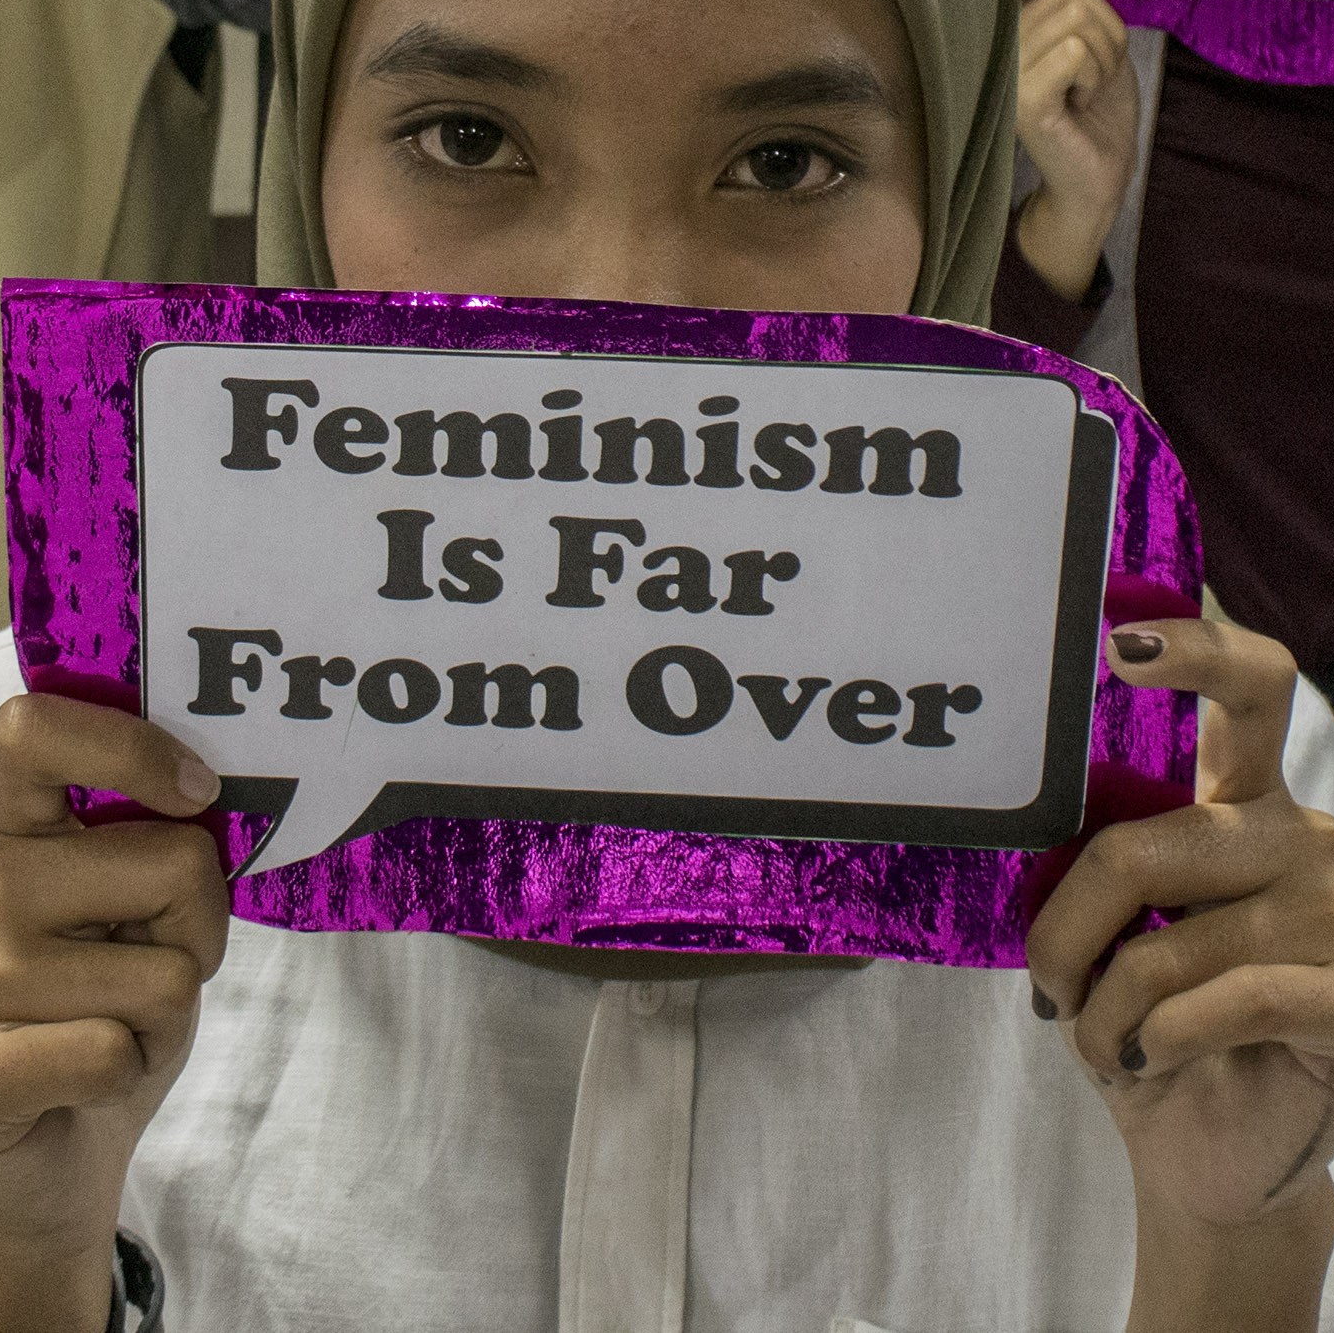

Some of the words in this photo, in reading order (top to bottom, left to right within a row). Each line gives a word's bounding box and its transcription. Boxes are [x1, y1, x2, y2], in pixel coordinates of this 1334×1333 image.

[219, 377, 963, 498] Feminism
[376, 508, 505, 606] Is
[544, 514, 802, 617] Far
[186, 625, 584, 732] From
[624, 643, 983, 749] Over
